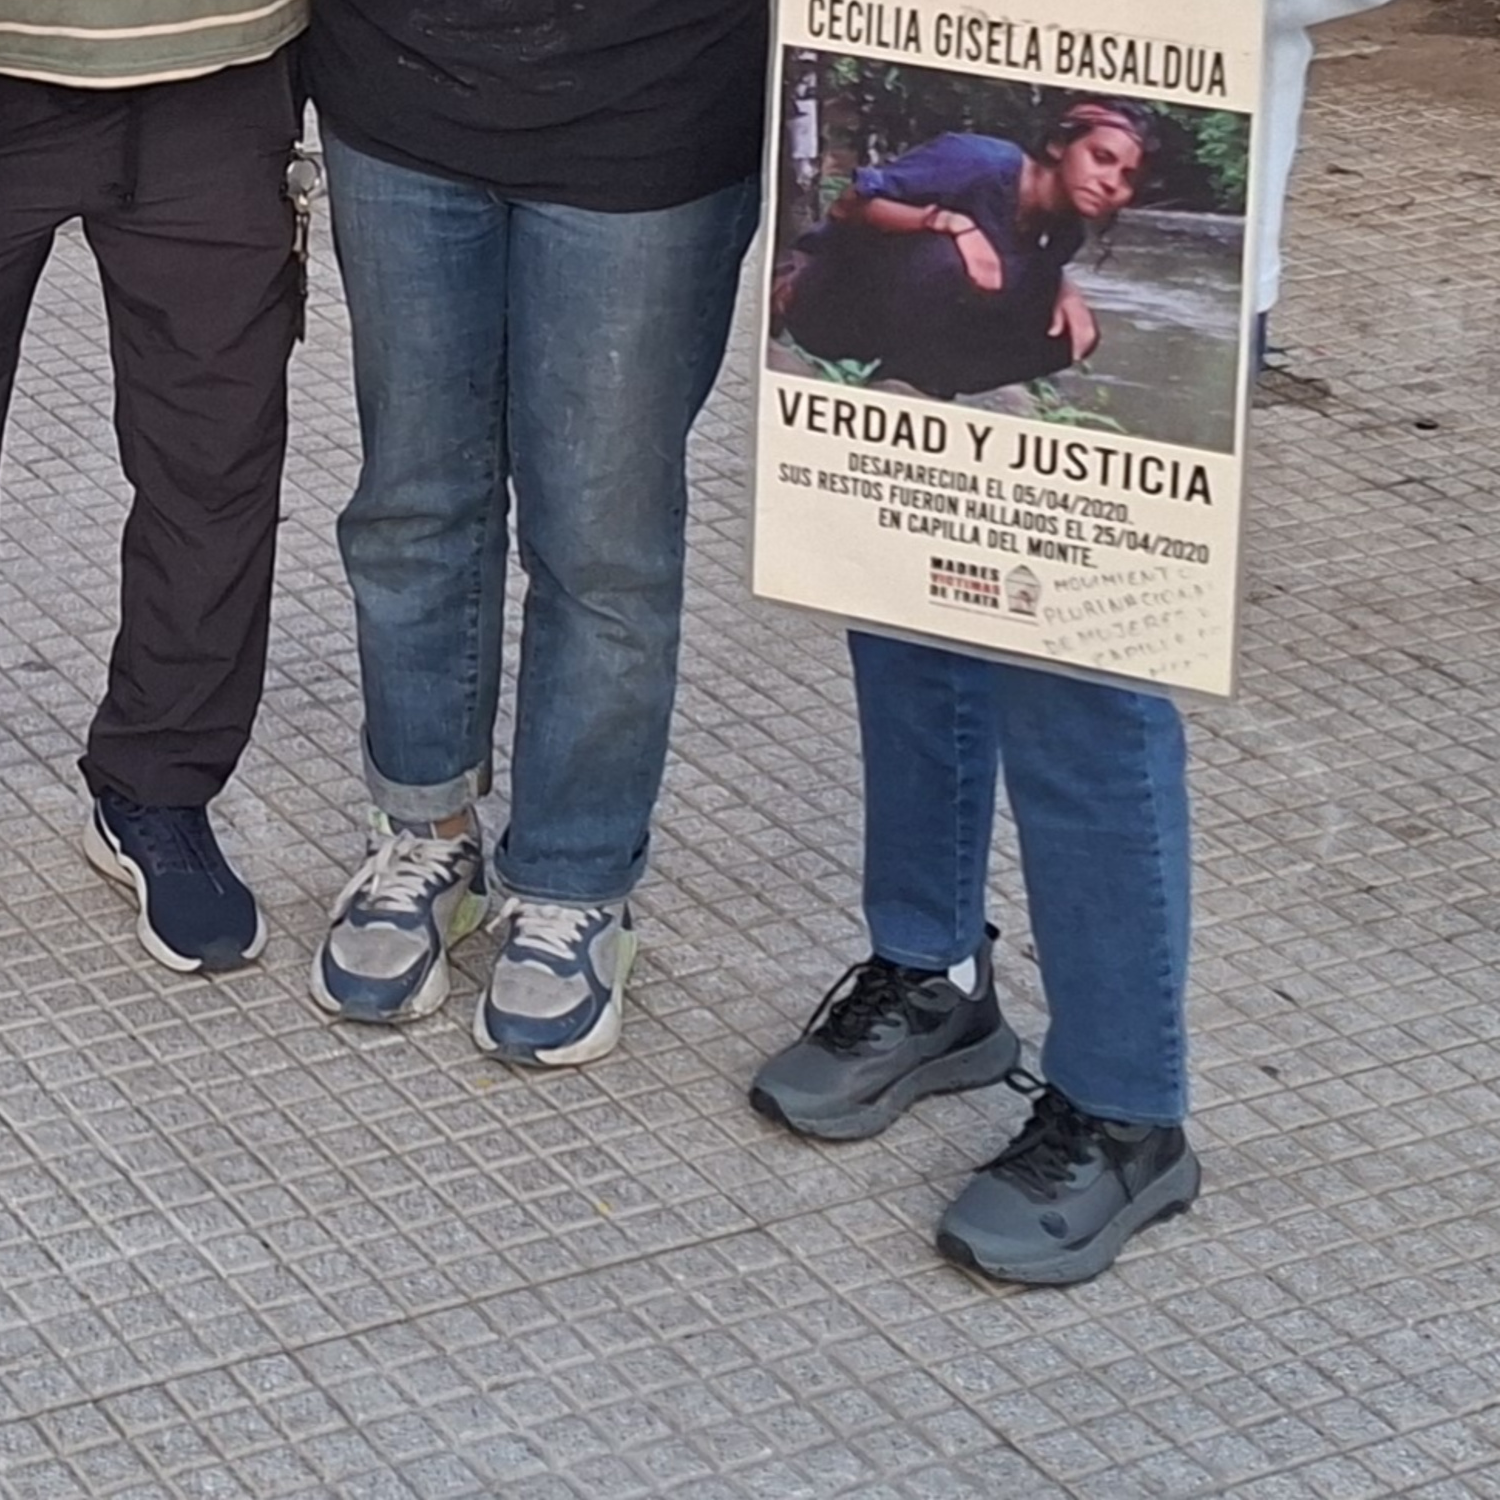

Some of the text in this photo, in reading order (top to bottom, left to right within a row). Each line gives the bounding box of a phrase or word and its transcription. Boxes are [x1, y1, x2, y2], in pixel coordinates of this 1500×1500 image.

[934, 12, 1043, 72] GISELA
[1055, 30, 1228, 97] BASALDUA
[778, 388, 1213, 507] VERDAD Y JUSTICIA
[778, 462, 1209, 565] SUS RESTOS FUERON HALLADOS EL 25/04/2020
[848, 452, 1134, 525] DESAPARECIDA EL 05/04/2020.
[879, 507, 1098, 568] EN CAPILLA DEL MONTE.
[930, 556, 999, 582] MADRES
[930, 572, 1001, 596] VICTIMAS
[930, 585, 1000, 610] DE TRATA
